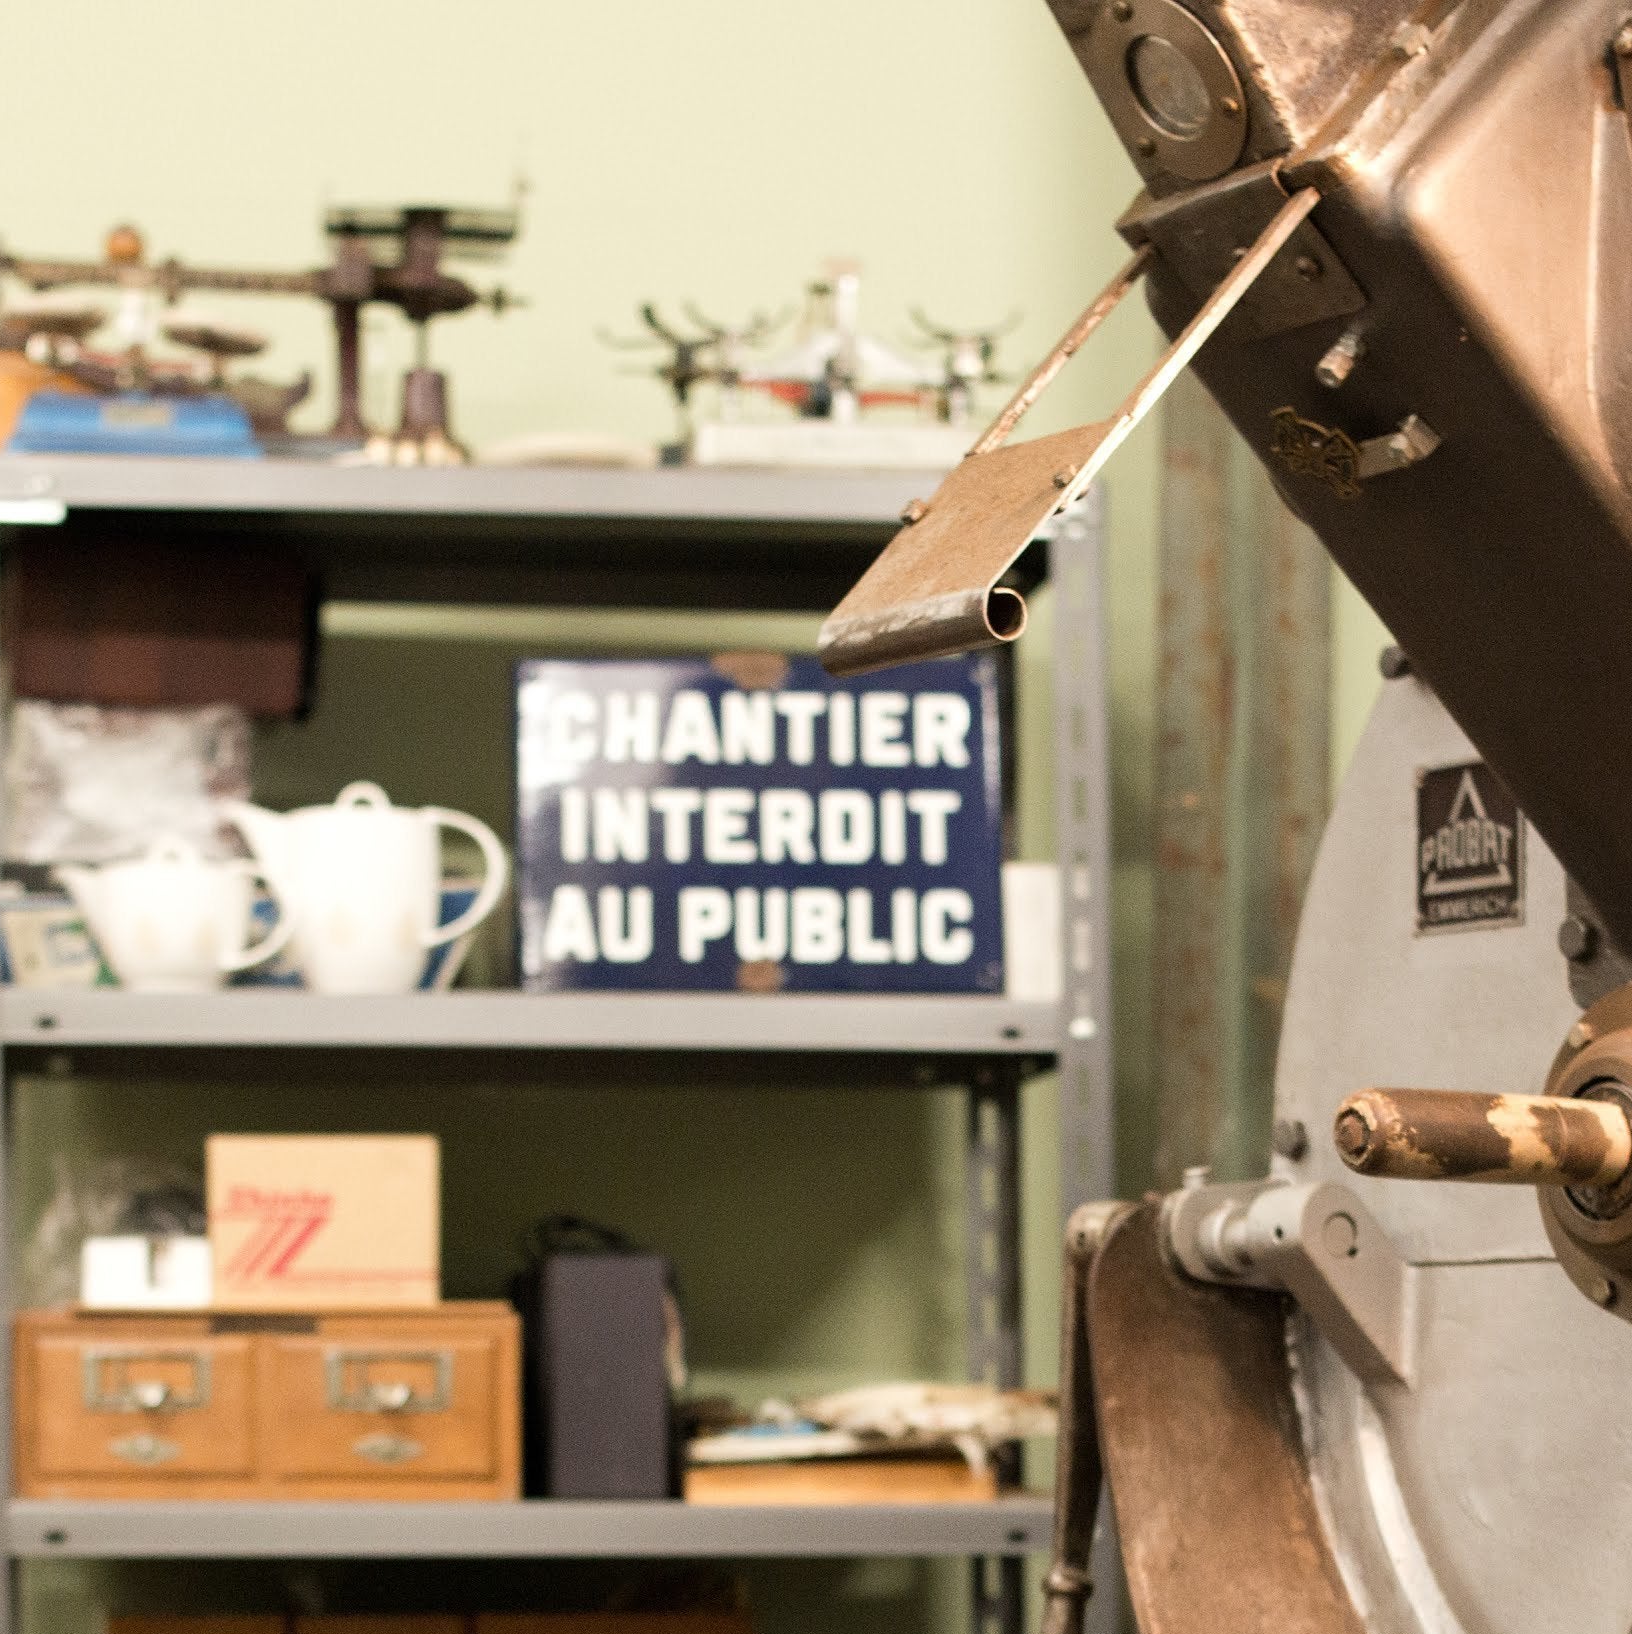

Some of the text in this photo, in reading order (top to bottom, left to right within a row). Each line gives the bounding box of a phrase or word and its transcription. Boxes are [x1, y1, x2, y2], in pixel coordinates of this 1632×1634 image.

[550, 690, 971, 768] CHANTIER
[560, 788, 962, 866] INTERDIT
[542, 884, 975, 965] AU PUBLIC
